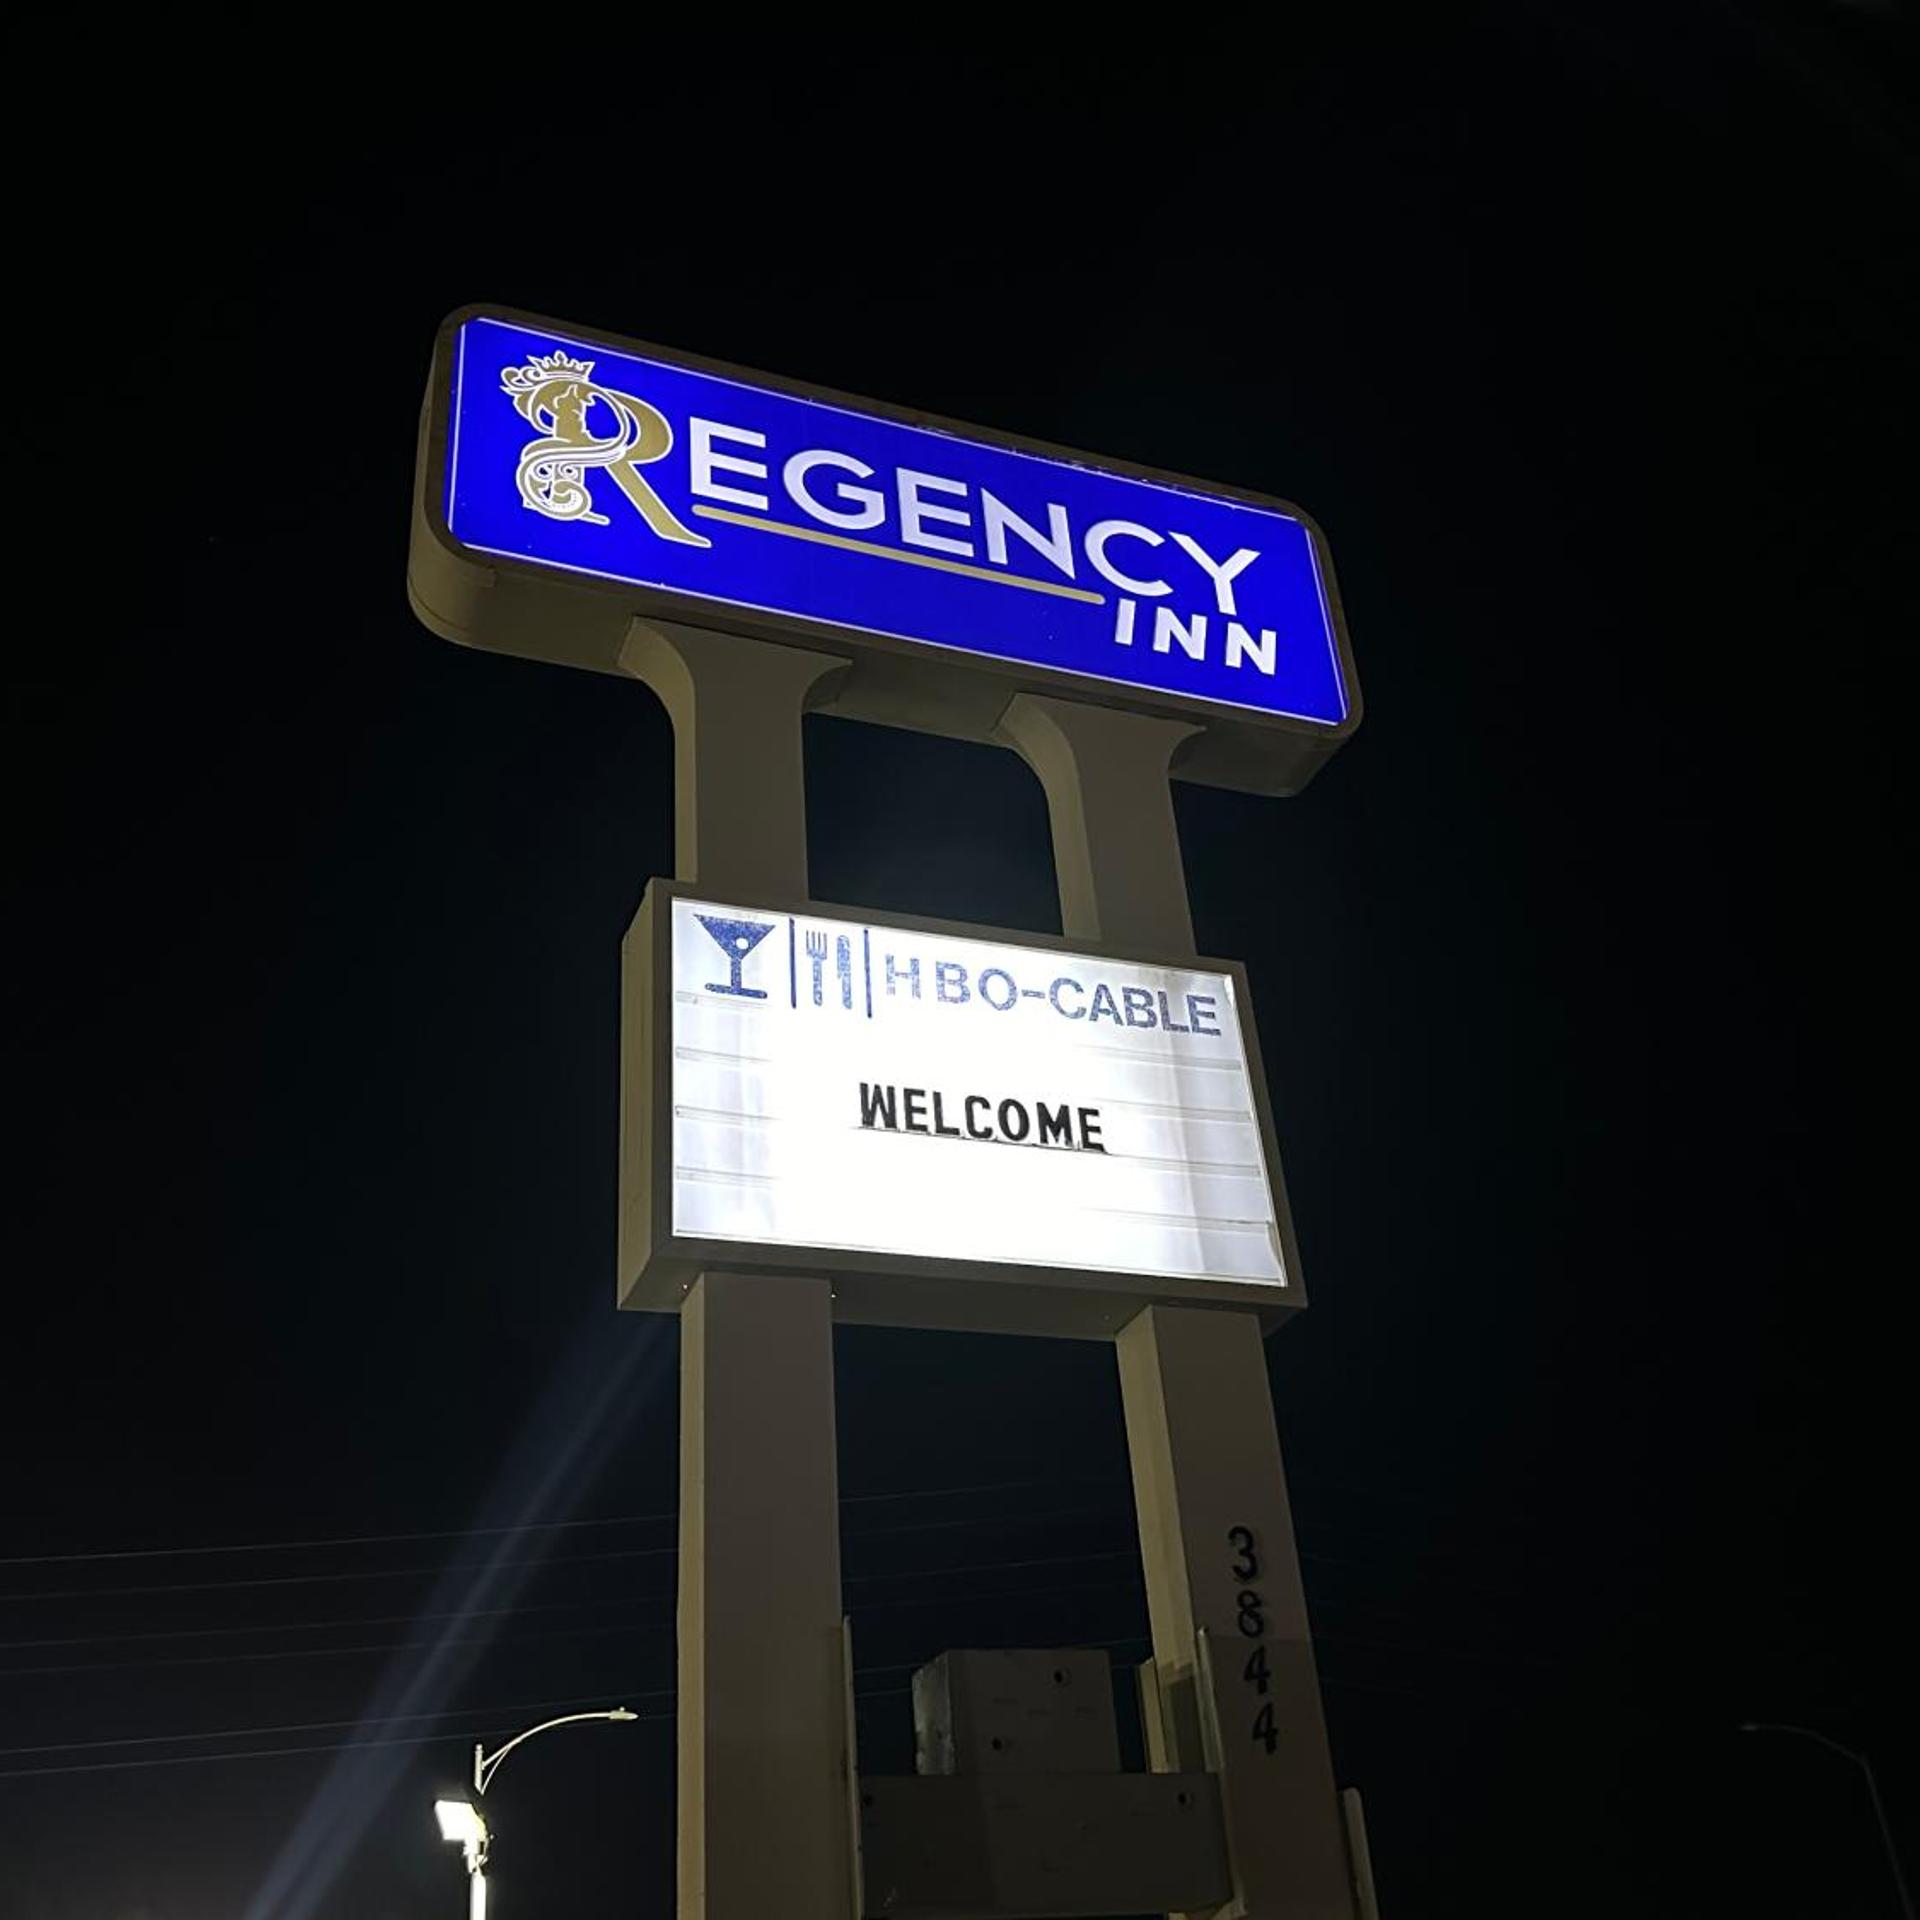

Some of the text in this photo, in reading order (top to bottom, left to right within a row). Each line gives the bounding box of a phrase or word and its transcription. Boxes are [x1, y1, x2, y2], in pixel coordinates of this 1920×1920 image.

[498, 351, 1260, 616] REGENCY
[1114, 598, 1278, 676] INN
[858, 1081, 1106, 1153] WELCOME
[1228, 1526, 1279, 1754] 3844
